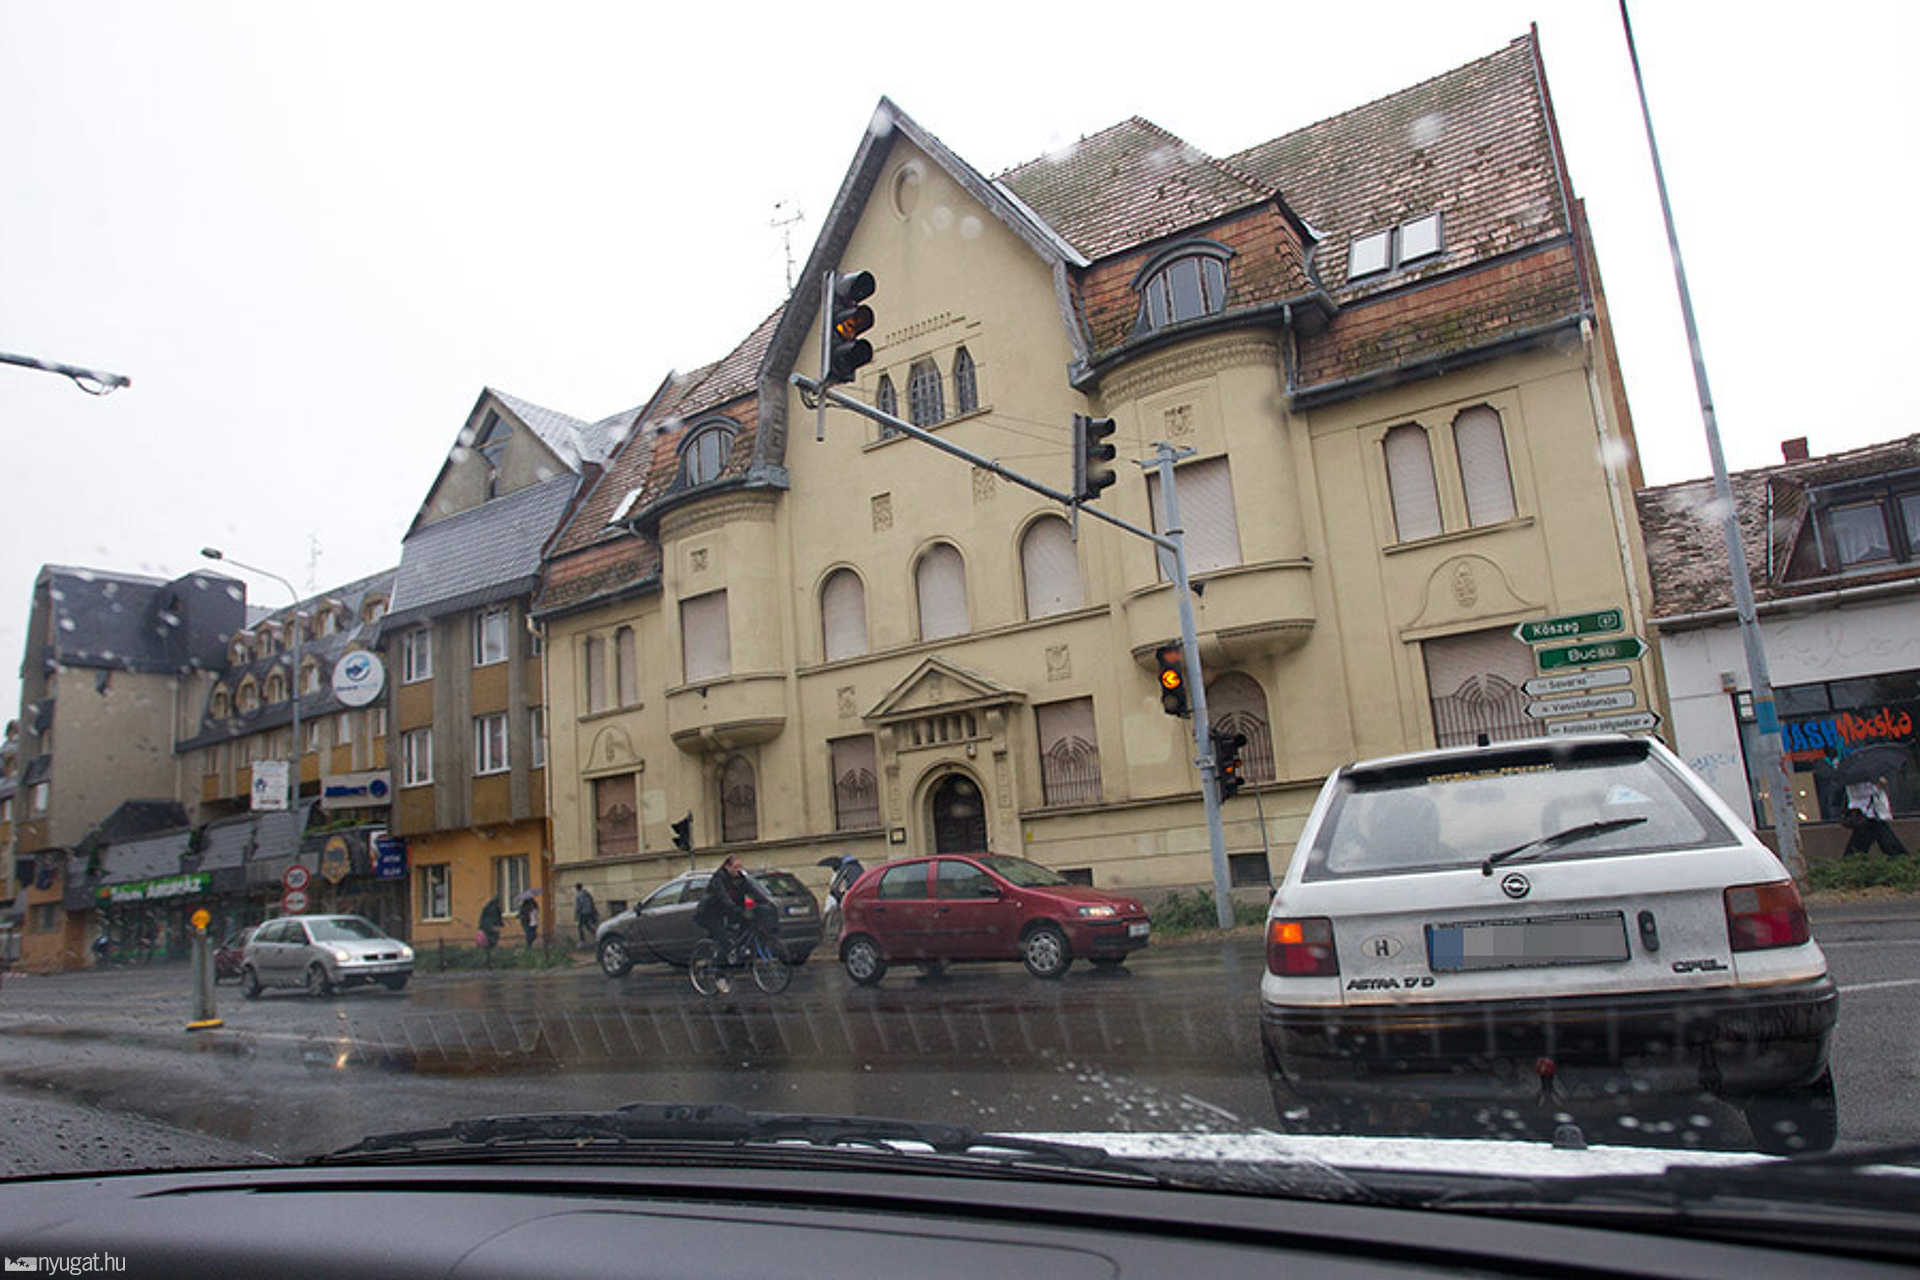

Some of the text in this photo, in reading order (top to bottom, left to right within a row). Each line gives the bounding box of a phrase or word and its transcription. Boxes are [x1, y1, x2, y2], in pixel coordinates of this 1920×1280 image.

[1375, 939, 1390, 957] H
[1672, 959, 1728, 973] OPEL
[1346, 978, 1401, 991] ASTRA
